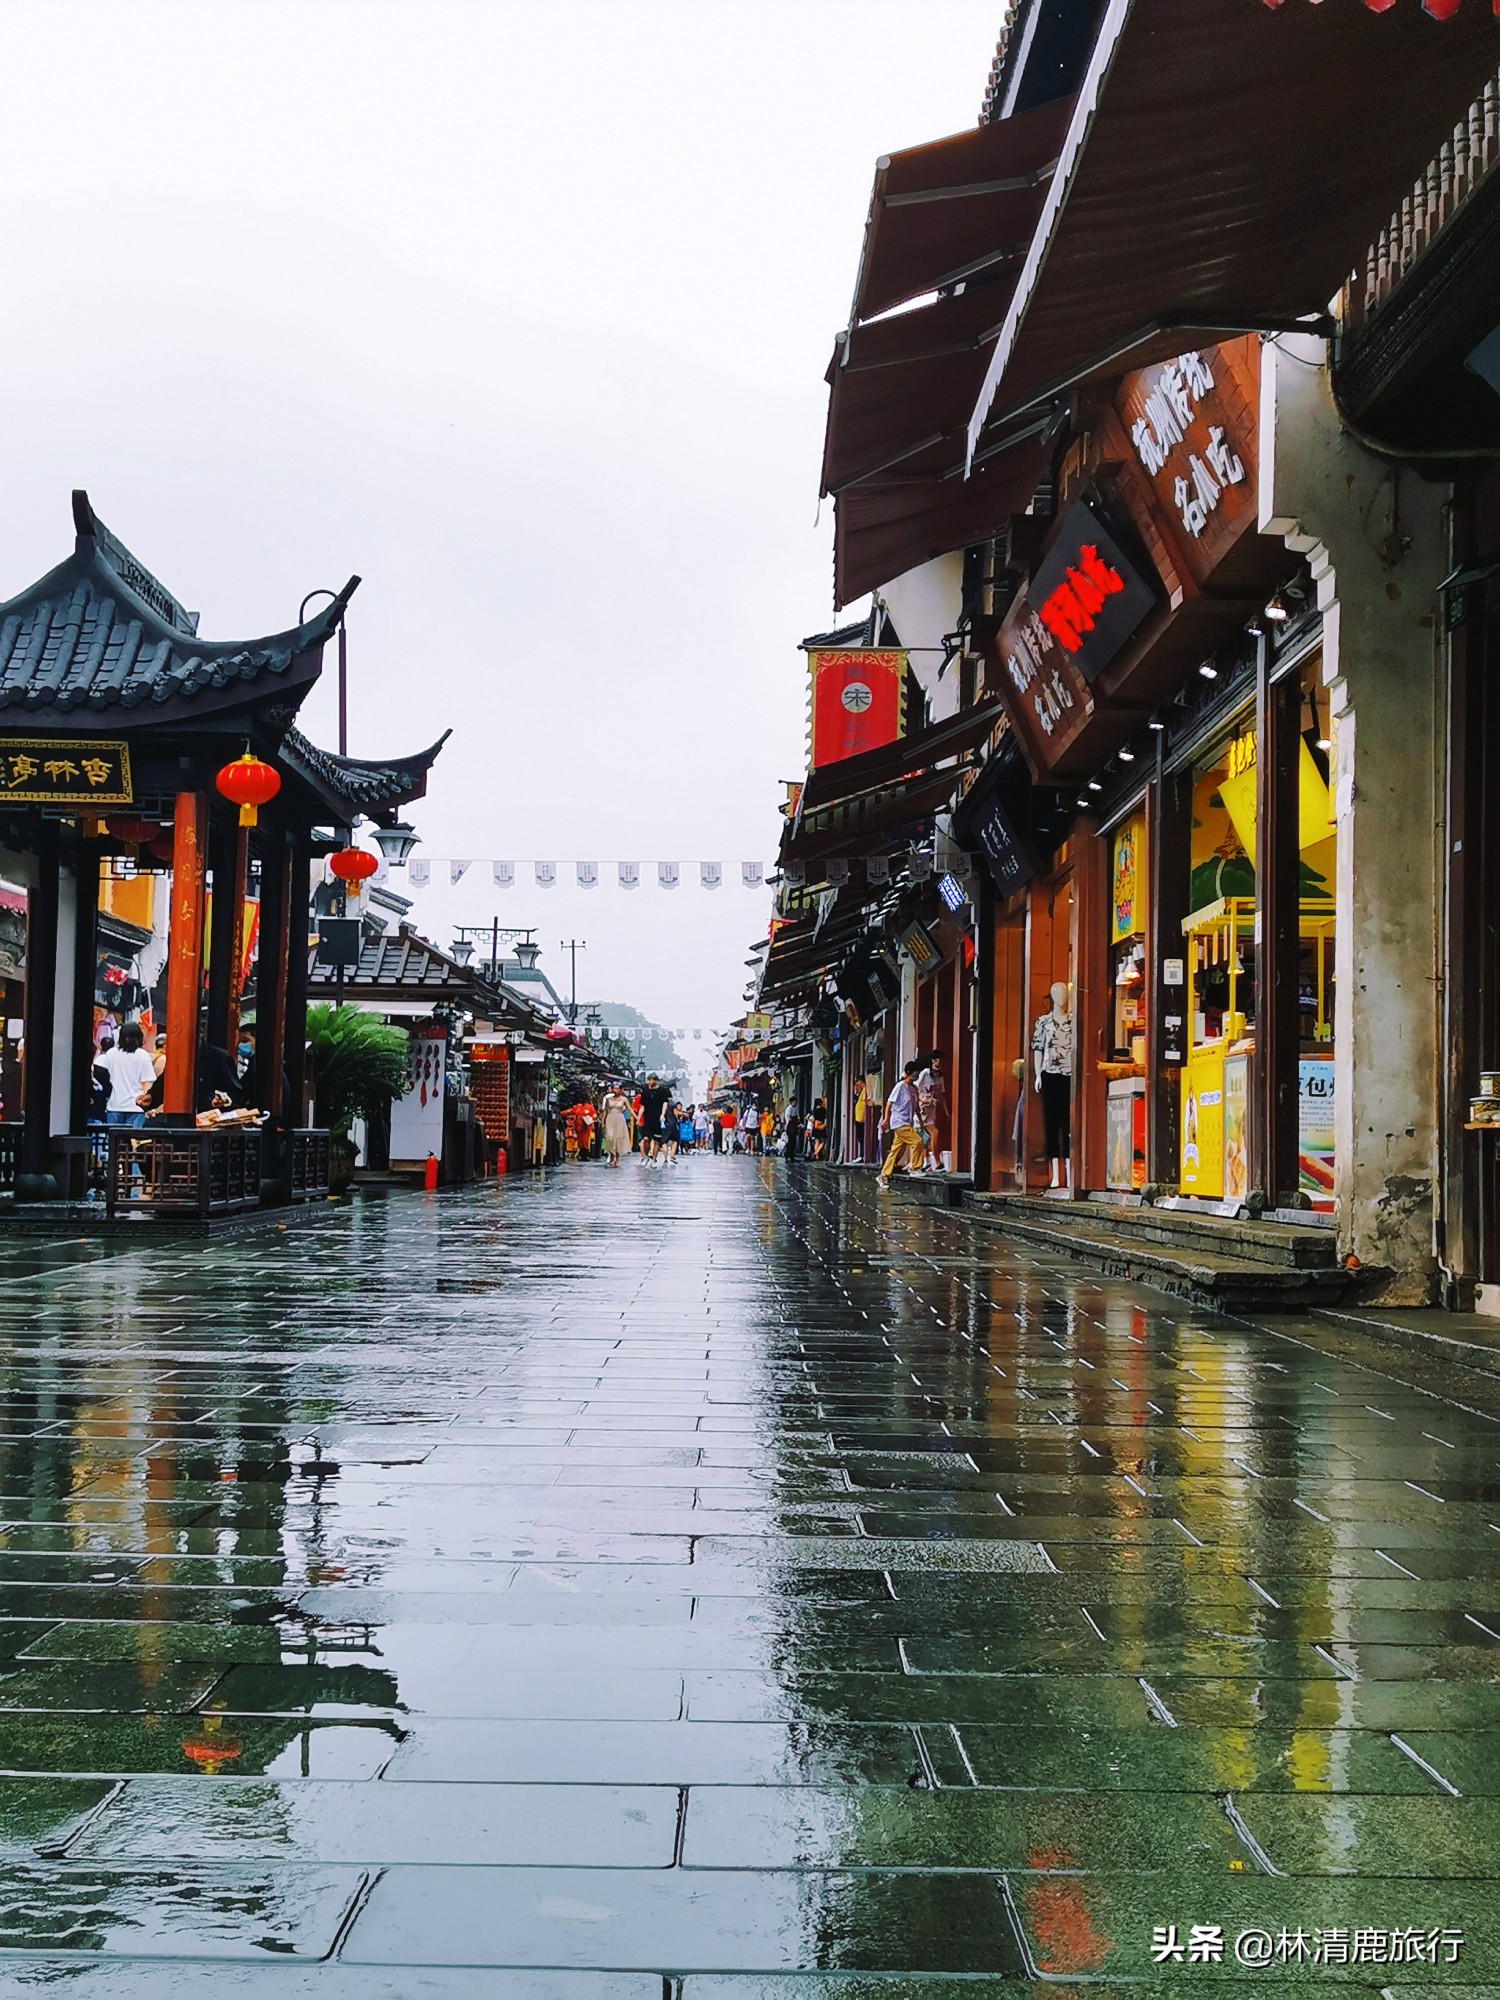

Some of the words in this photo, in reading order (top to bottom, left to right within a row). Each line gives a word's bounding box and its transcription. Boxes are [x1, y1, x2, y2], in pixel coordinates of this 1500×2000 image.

[1132, 351, 1215, 477] 杭州传统
[1174, 425, 1244, 538] 名小吃
[1034, 668, 1074, 736] 名小吃
